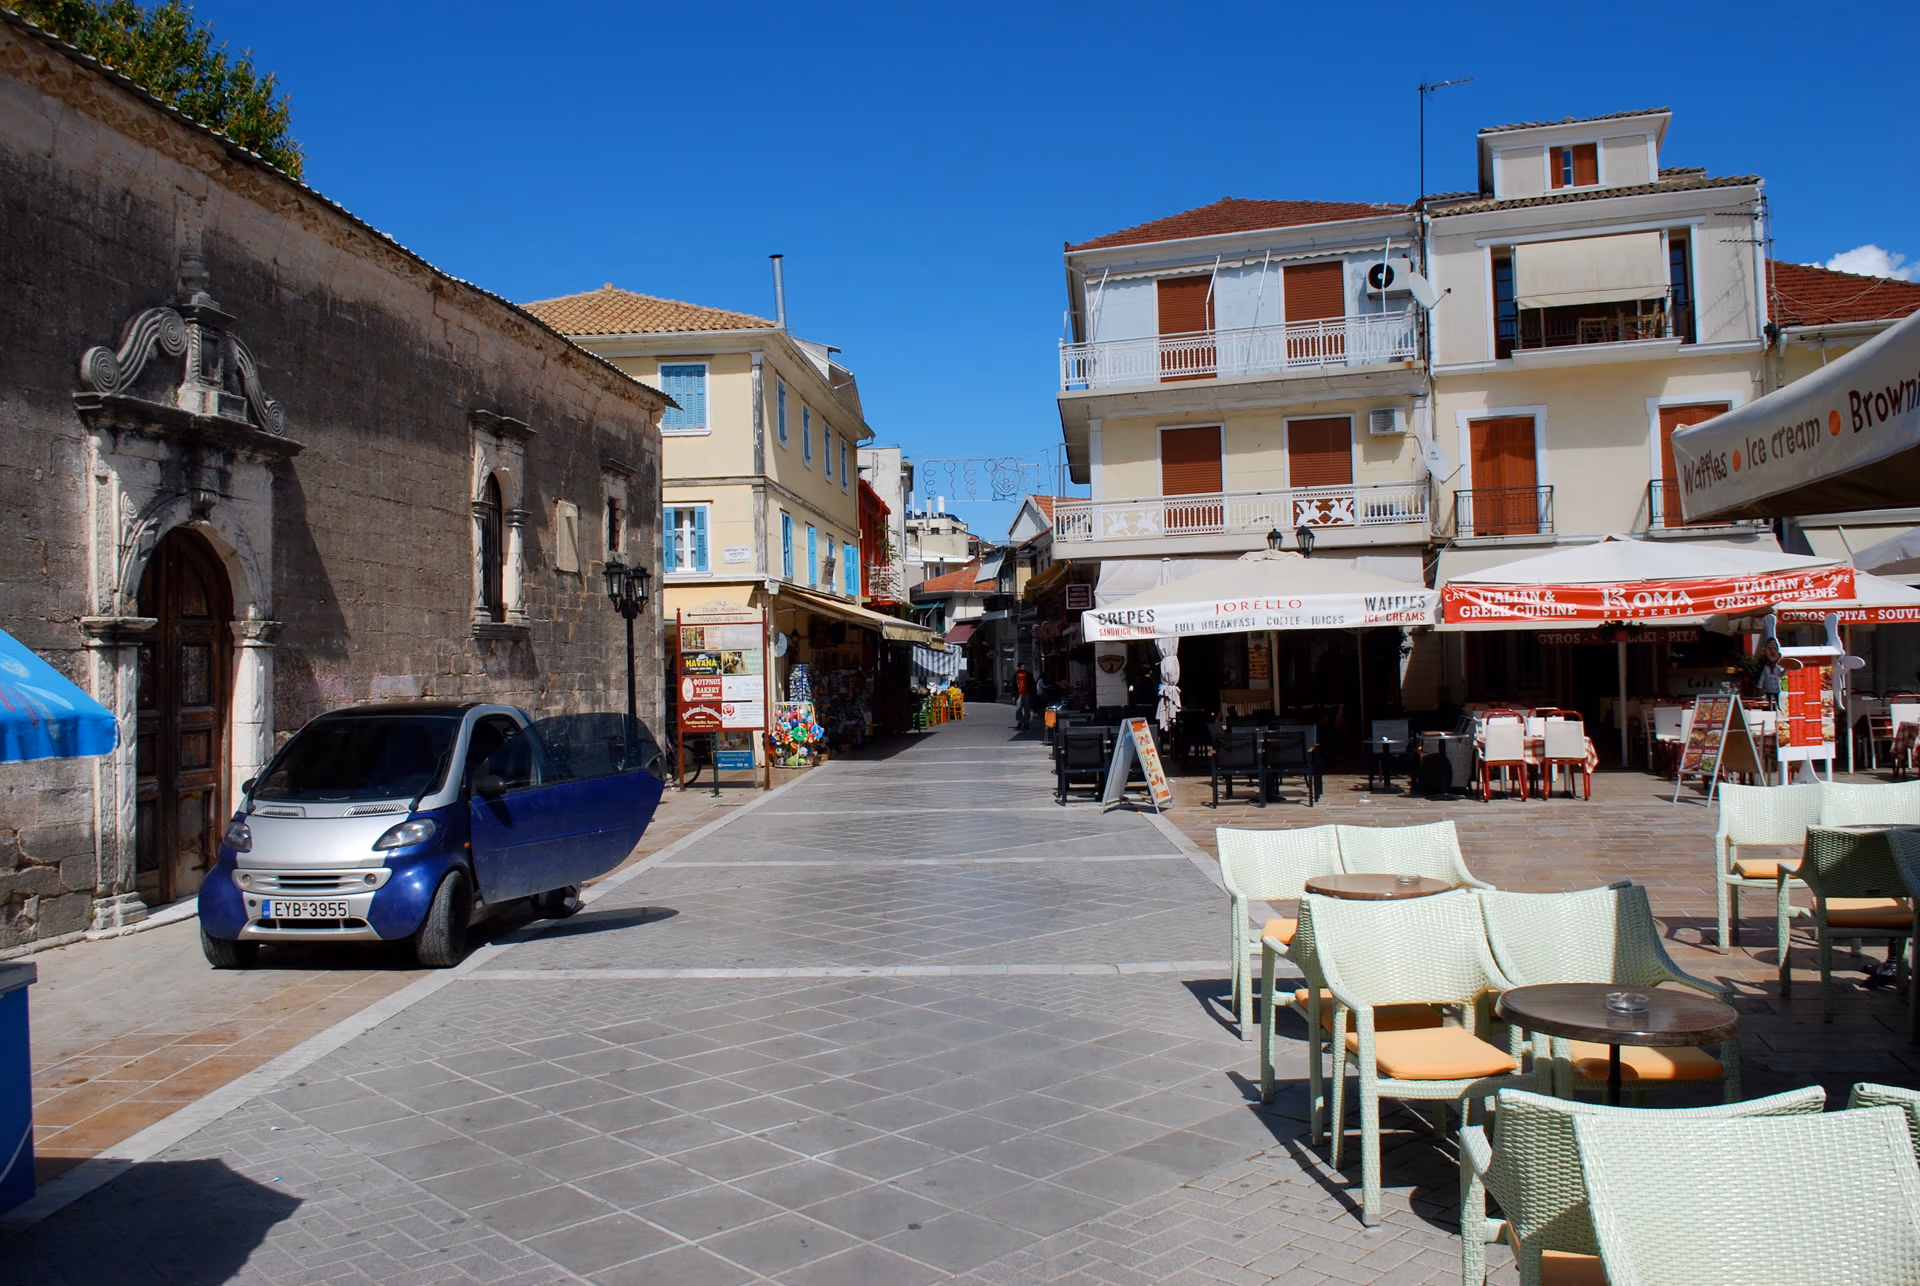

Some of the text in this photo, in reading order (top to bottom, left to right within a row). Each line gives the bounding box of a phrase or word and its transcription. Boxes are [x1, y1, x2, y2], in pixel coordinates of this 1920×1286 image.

[1682, 449, 1728, 496] Waffles
[1745, 437, 1767, 470] Ice
[1771, 417, 1821, 460] cream
[1734, 576, 1814, 594] ITALIAN &
[1364, 595, 1426, 612] WAFFLES
[1479, 590, 1556, 603] ITALIAN &
[1713, 587, 1838, 609] GREEK CUISINE
[1215, 599, 1303, 615] JORELLO
[1459, 603, 1577, 618] GREEK CUISINE
[1603, 608, 1695, 618] PIZZERIA
[1098, 608, 1155, 626] CREPES
[1364, 611, 1426, 623] ICE CREAMS
[1781, 611, 1825, 621] GYROS
[1836, 609, 1868, 621] PITA
[1201, 617, 1256, 630] BREAKFAST
[1311, 615, 1345, 626] JUICES
[1099, 626, 1131, 637] SANDWICH
[1537, 633, 1581, 644] GYROS
[1667, 630, 1699, 642] PITA
[685, 658, 718, 668] HAVANA
[695, 686, 720, 694] BAKERY
